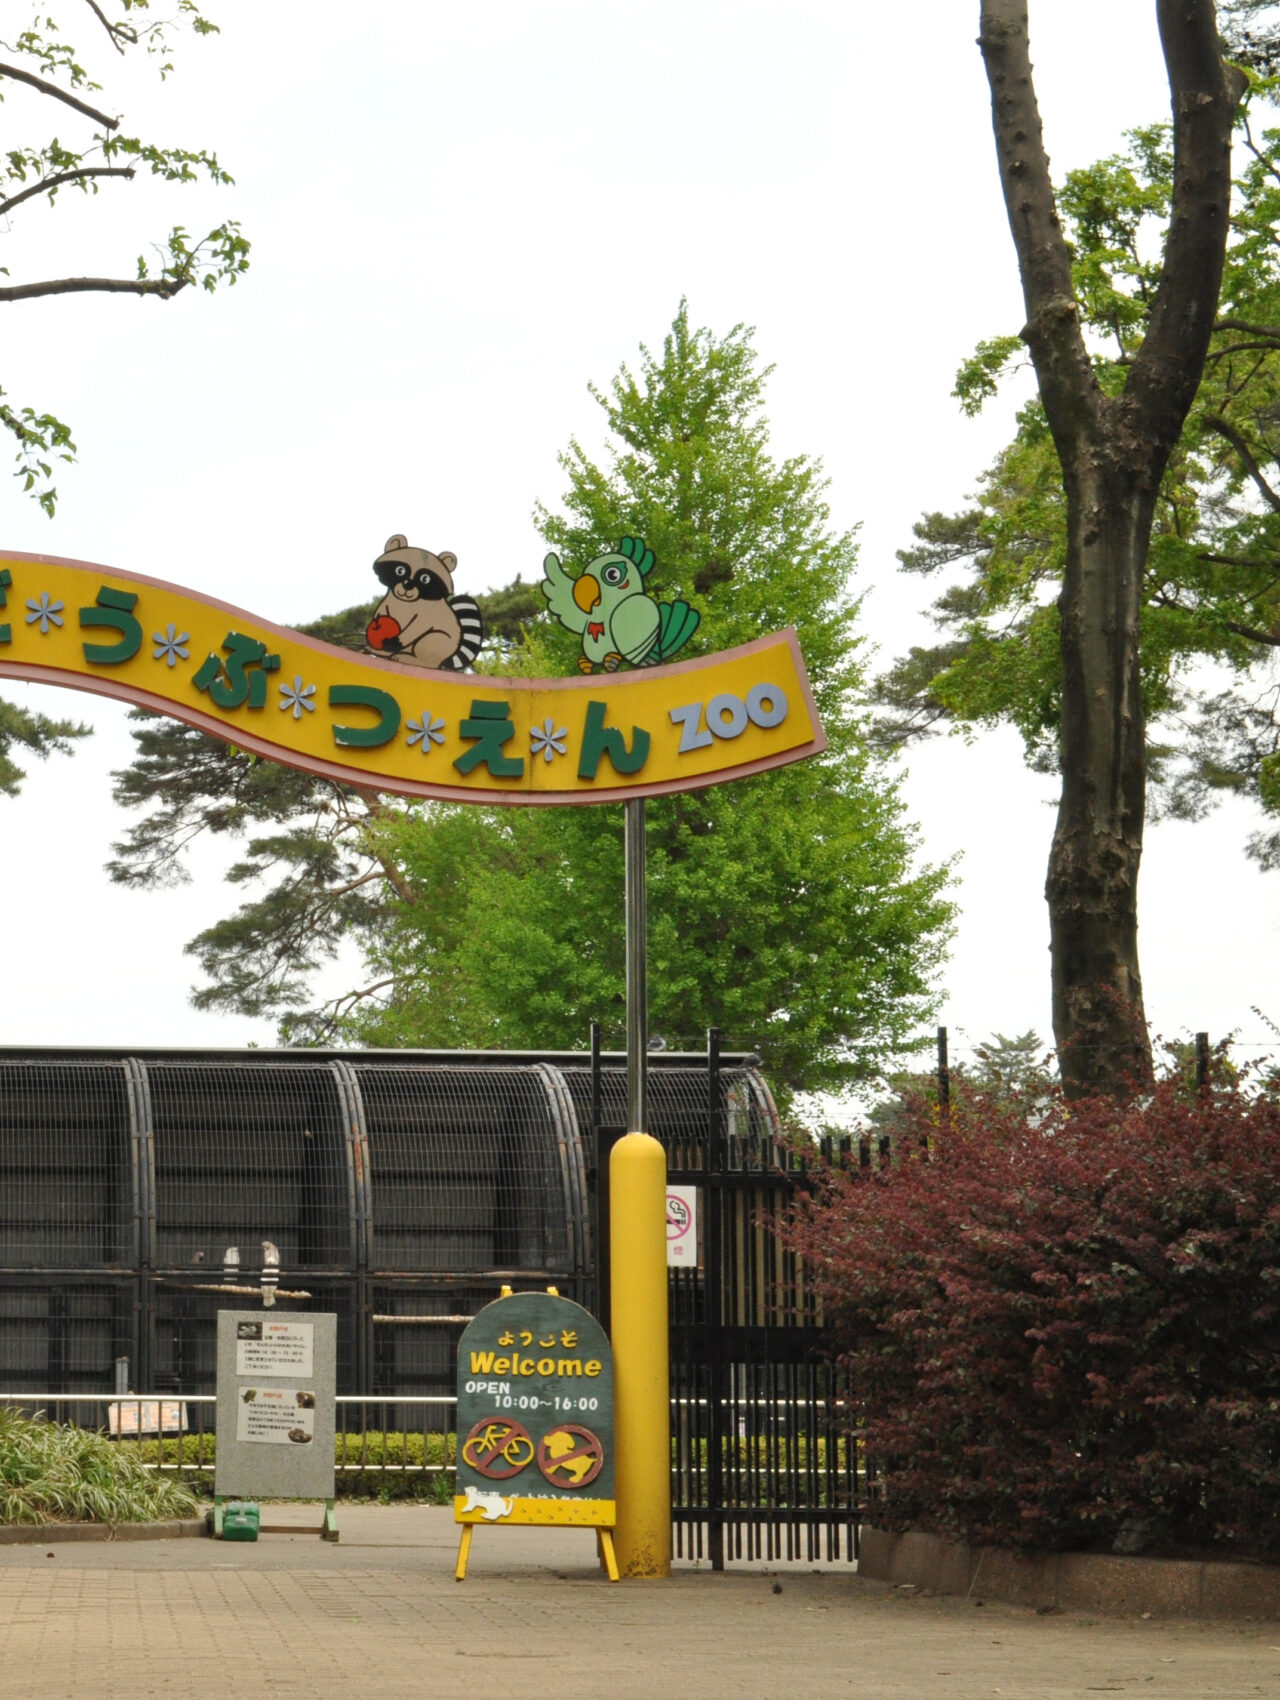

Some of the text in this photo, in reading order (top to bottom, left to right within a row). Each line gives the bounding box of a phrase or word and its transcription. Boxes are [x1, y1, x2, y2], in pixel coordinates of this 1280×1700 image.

[669, 682, 788, 753] ZOO
[498, 1330, 578, 1347] ようこそ
[470, 1351, 602, 1377] Welcome
[465, 1381, 510, 1395] OPEN
